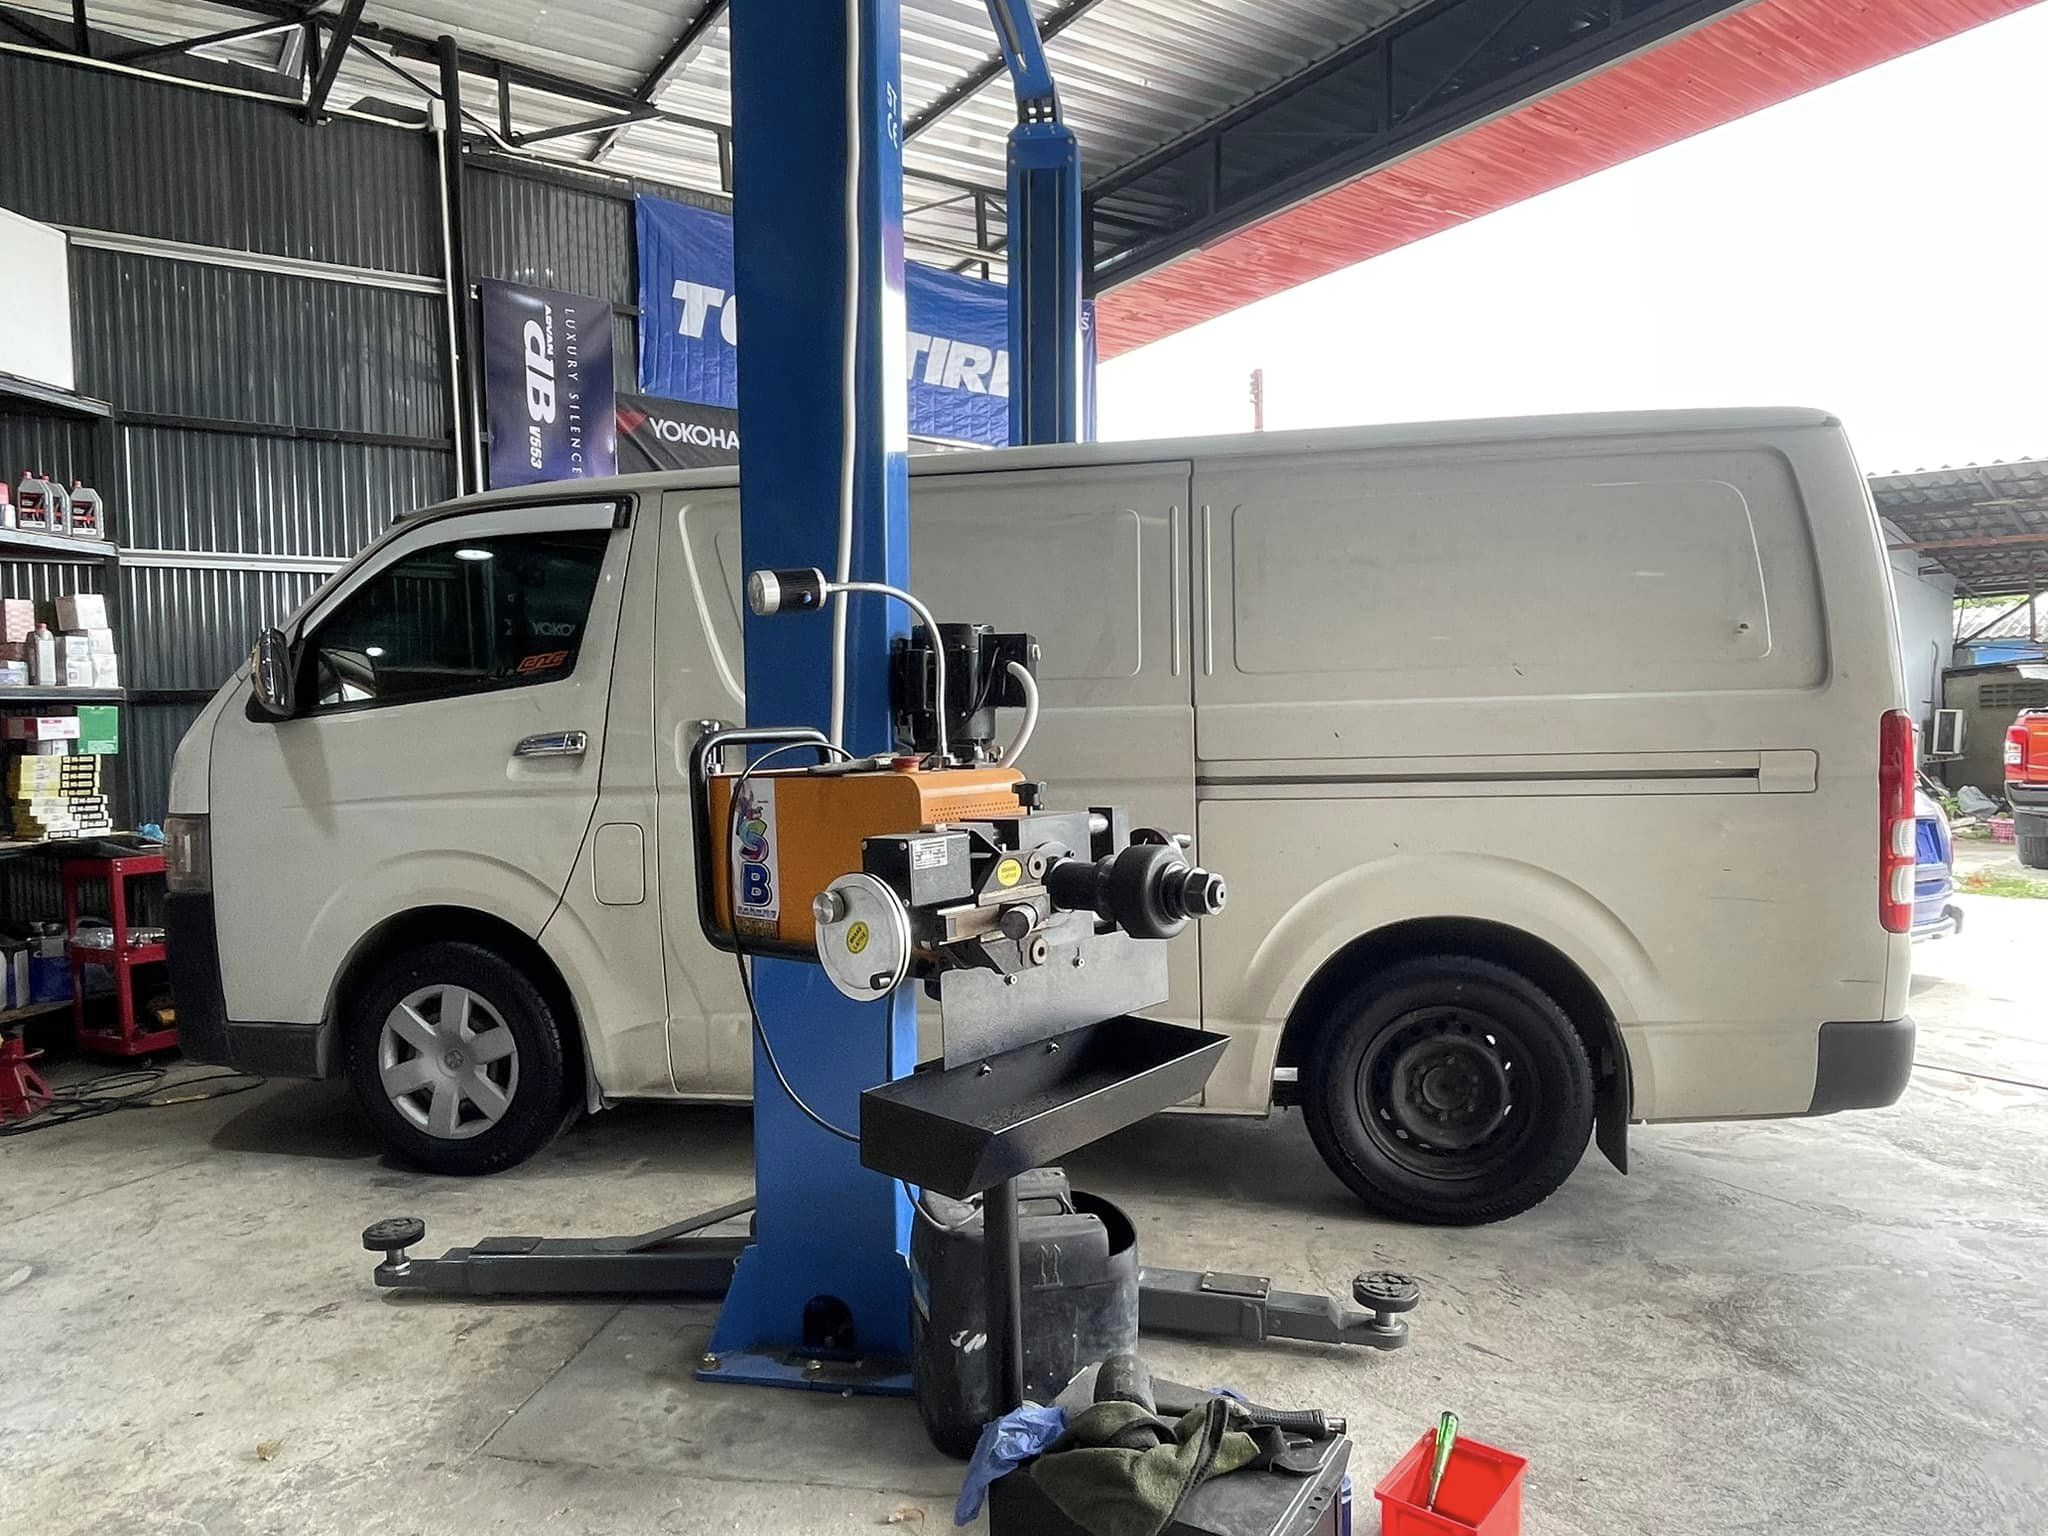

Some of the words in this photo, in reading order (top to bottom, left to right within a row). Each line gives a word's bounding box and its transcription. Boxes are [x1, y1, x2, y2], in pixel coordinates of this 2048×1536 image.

[544, 304, 555, 355] ADVAN
[564, 308, 578, 382] LUXURY
[523, 319, 556, 424] dB
[568, 392, 583, 474] SILENCE
